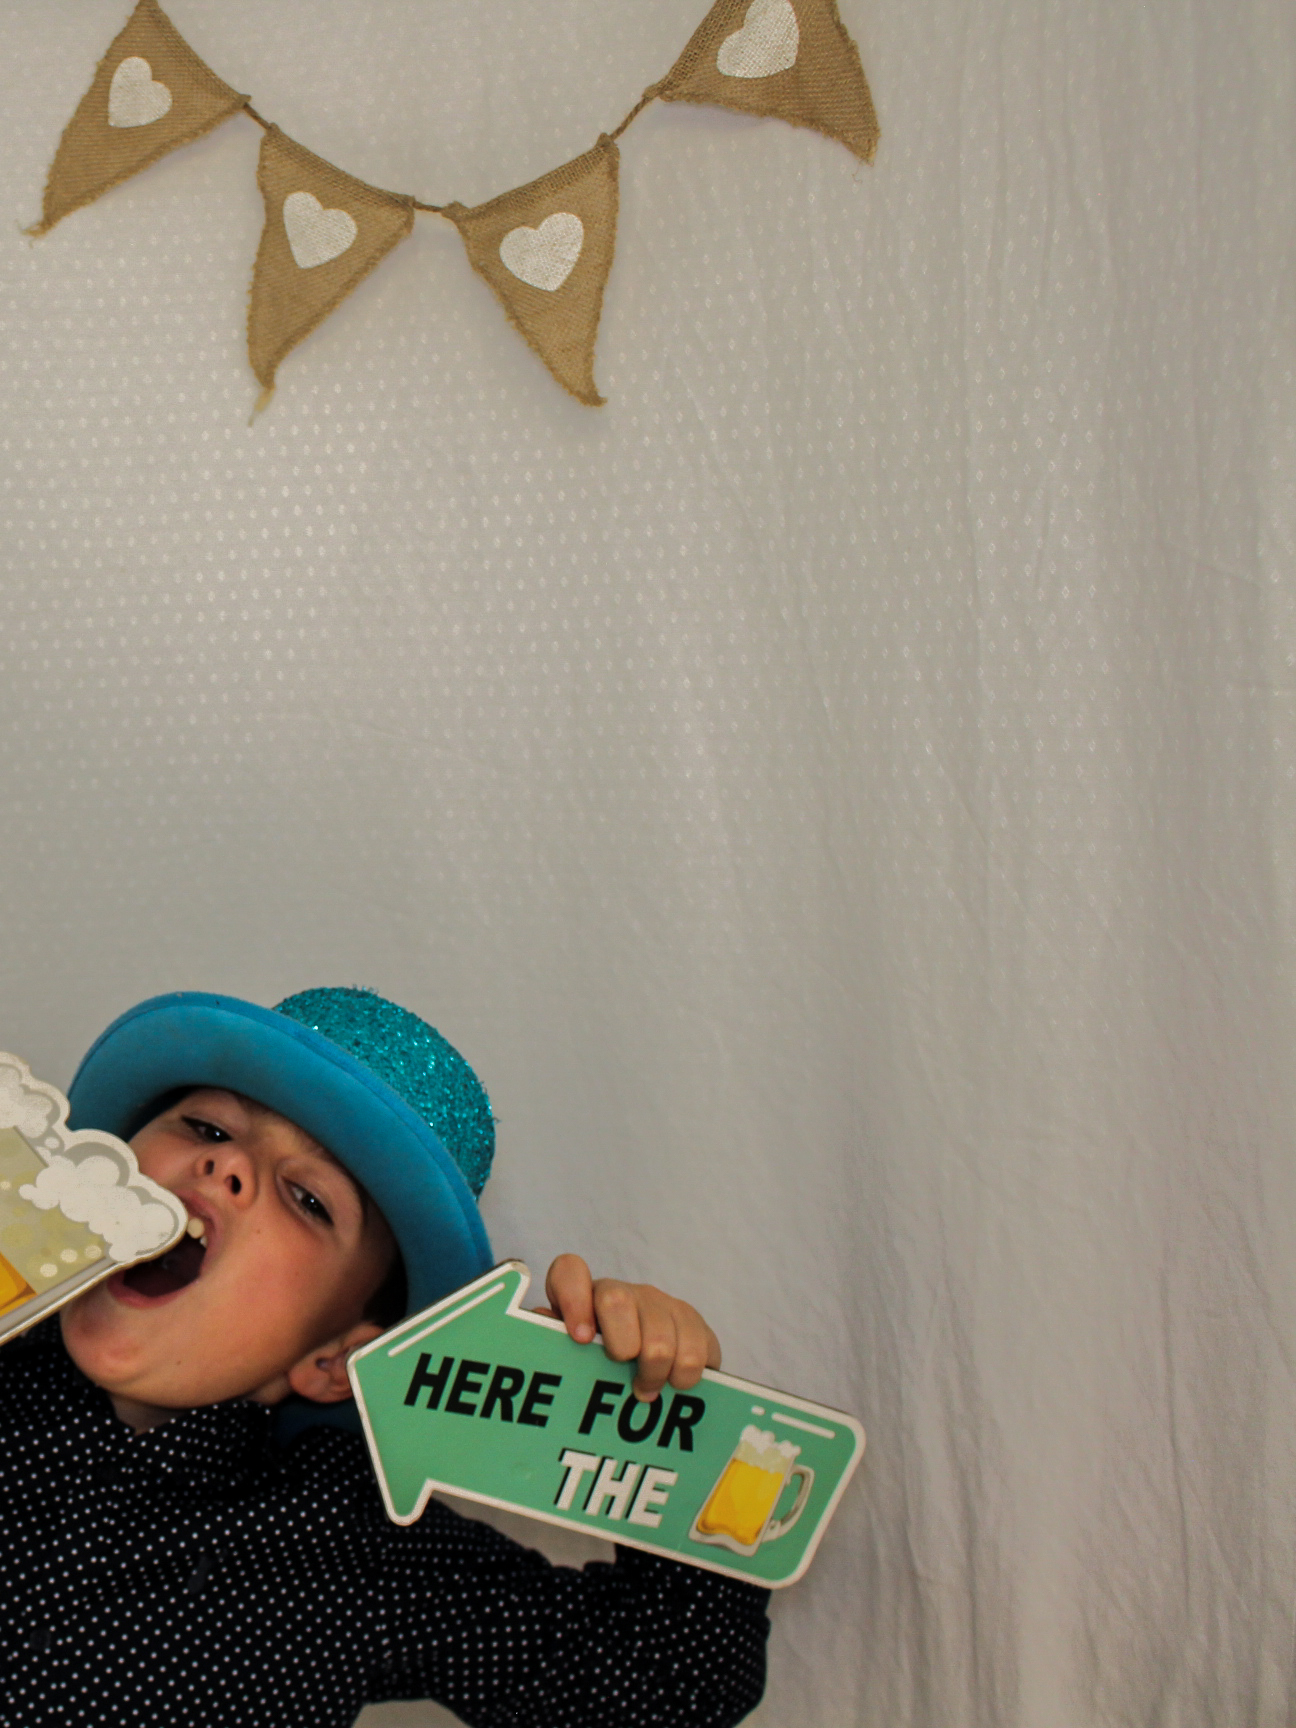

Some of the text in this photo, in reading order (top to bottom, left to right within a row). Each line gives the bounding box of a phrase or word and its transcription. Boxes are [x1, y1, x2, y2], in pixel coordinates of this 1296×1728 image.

[404, 1353, 706, 1452] HERE FOR
[554, 1448, 678, 1529] THE
